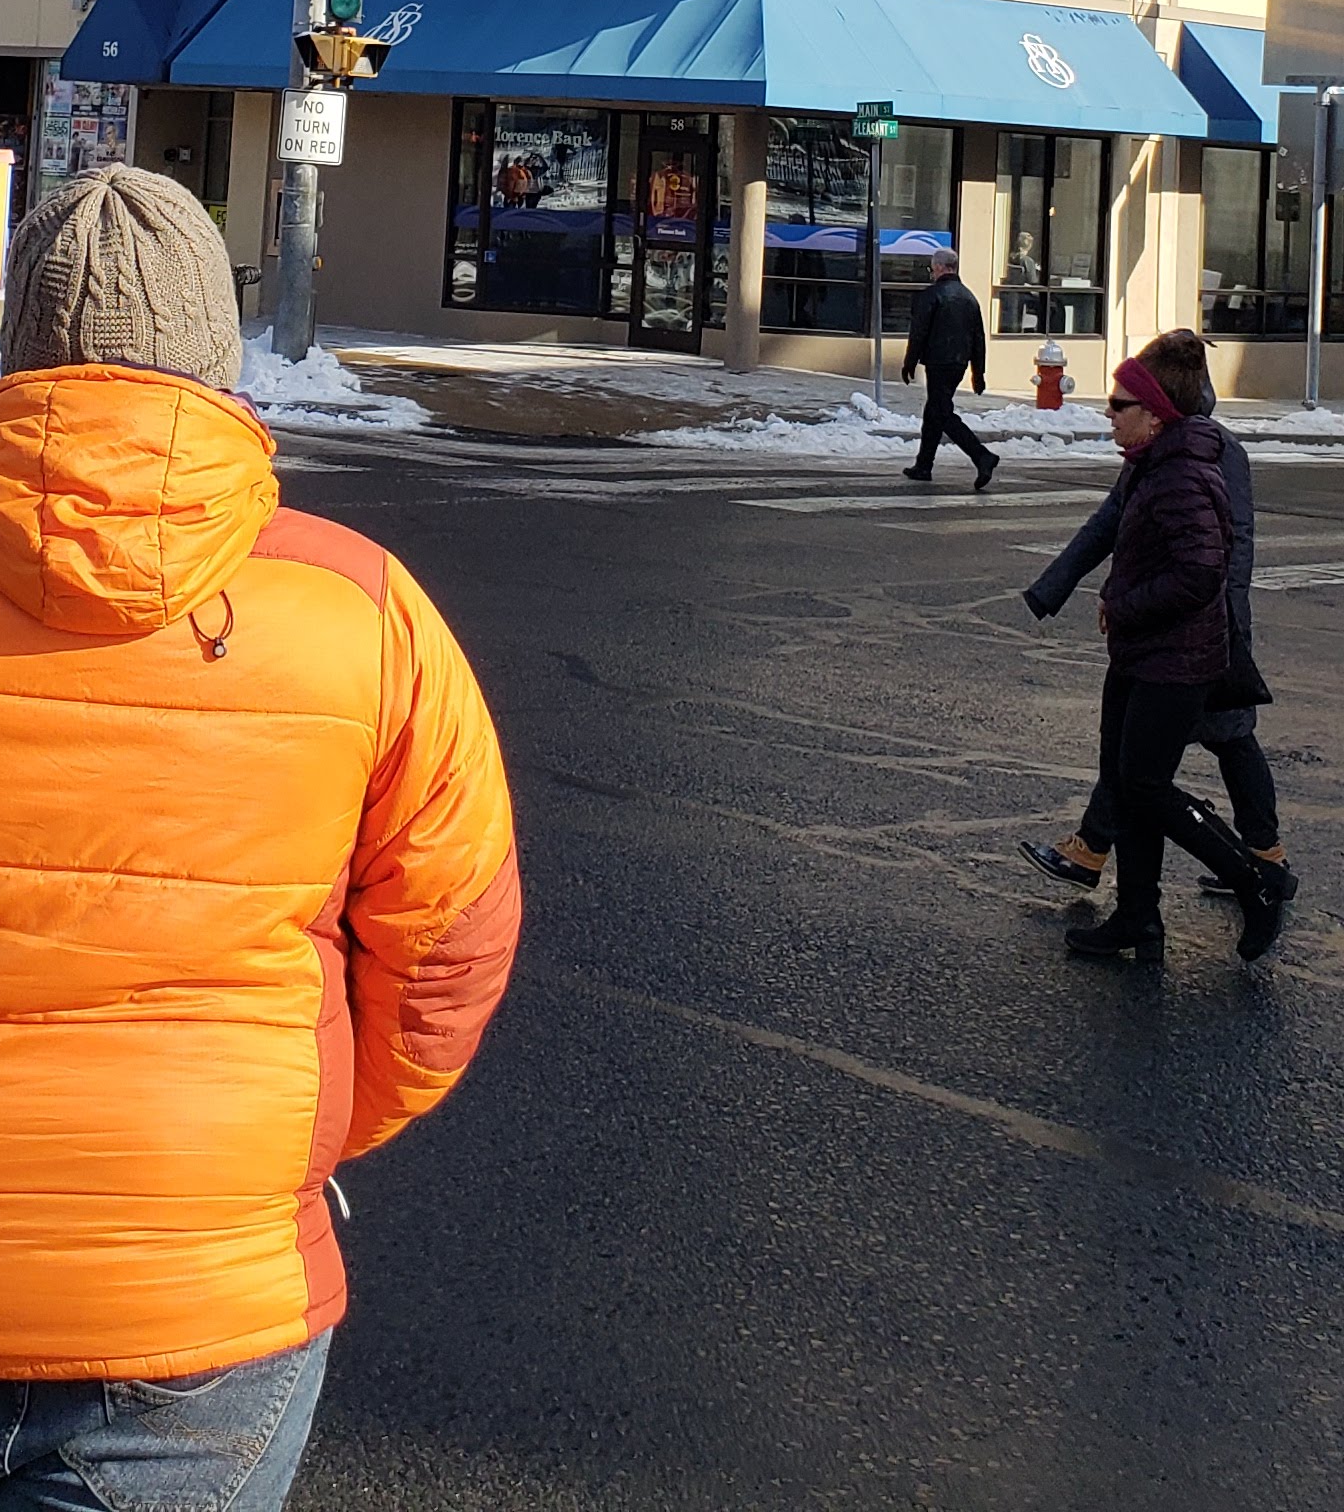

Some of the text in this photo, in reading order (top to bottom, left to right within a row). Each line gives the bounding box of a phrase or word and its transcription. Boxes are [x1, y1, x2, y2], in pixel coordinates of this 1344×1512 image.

[102, 41, 119, 57] 56
[303, 101, 325, 115] NO
[858, 104, 879, 117] MAIN
[294, 119, 331, 134] TURN
[670, 118, 685, 131] 58
[852, 120, 889, 137] PLEASANT
[284, 138, 337, 155] ON RED
[552, 130, 593, 148] Bank
